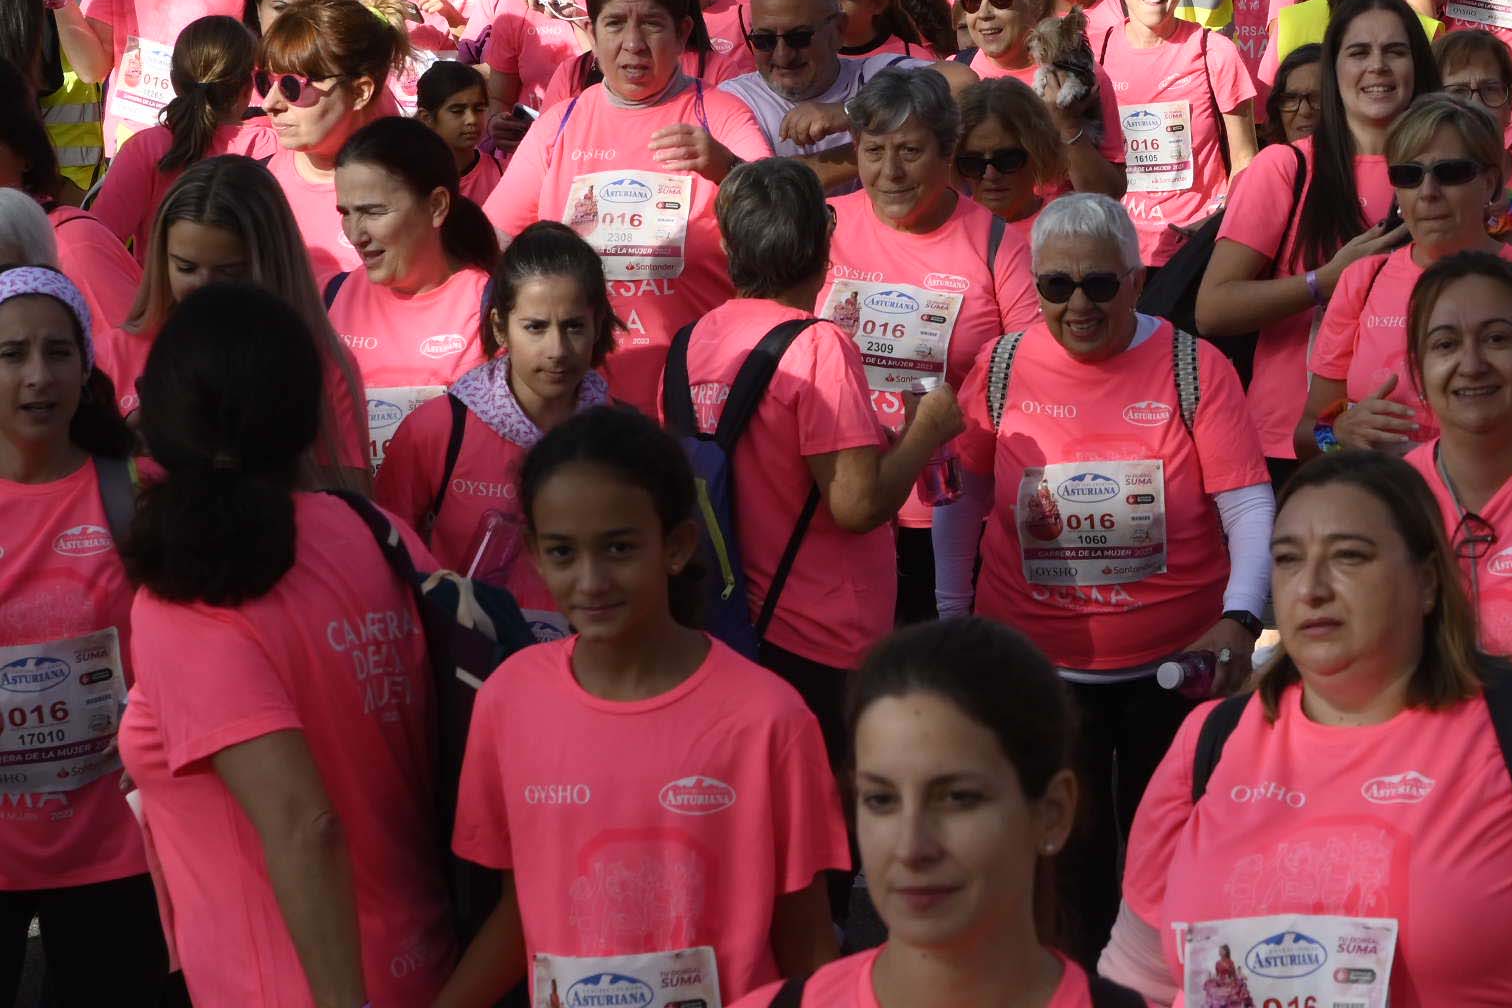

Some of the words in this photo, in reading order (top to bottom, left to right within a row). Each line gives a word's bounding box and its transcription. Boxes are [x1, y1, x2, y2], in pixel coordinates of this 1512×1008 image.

[144, 73, 170, 91] 016
[1130, 138, 1160, 152] 016
[1135, 155, 1159, 163] 16105
[601, 213, 644, 229] 016
[607, 232, 634, 243] 2308
[635, 263, 675, 273] Santander
[832, 264, 884, 282] OYSHO
[868, 297, 916, 311] ASTURIANA
[862, 319, 906, 338] 016
[866, 341, 894, 354] 2309
[877, 357, 888, 365] LA
[1021, 399, 1077, 419] OYSHO
[1125, 477, 1153, 486] SUMA
[1062, 485, 1116, 497] ASTURIANA
[1066, 513, 1116, 530] 016
[1077, 535, 1108, 545] 1060
[1078, 549, 1089, 557] DE
[1090, 549, 1102, 557] LA
[1103, 549, 1132, 557] MUJER
[1035, 566, 1078, 578] OYSHO
[75, 650, 107, 665] SUMA
[0, 667, 66, 687] ASTURIANA
[8, 700, 70, 728] 016
[18, 728, 66, 747] 17010
[24, 750, 40, 761] DE
[41, 749, 55, 759] LA
[56, 744, 92, 758] MUJER
[524, 783, 591, 805] OYSHO
[665, 789, 731, 806] ASTURIANA
[1336, 943, 1379, 956] SUMA
[1252, 950, 1321, 970] ASTURIANA
[661, 974, 702, 989] SUMA
[572, 990, 648, 1008] ASTURIANA
